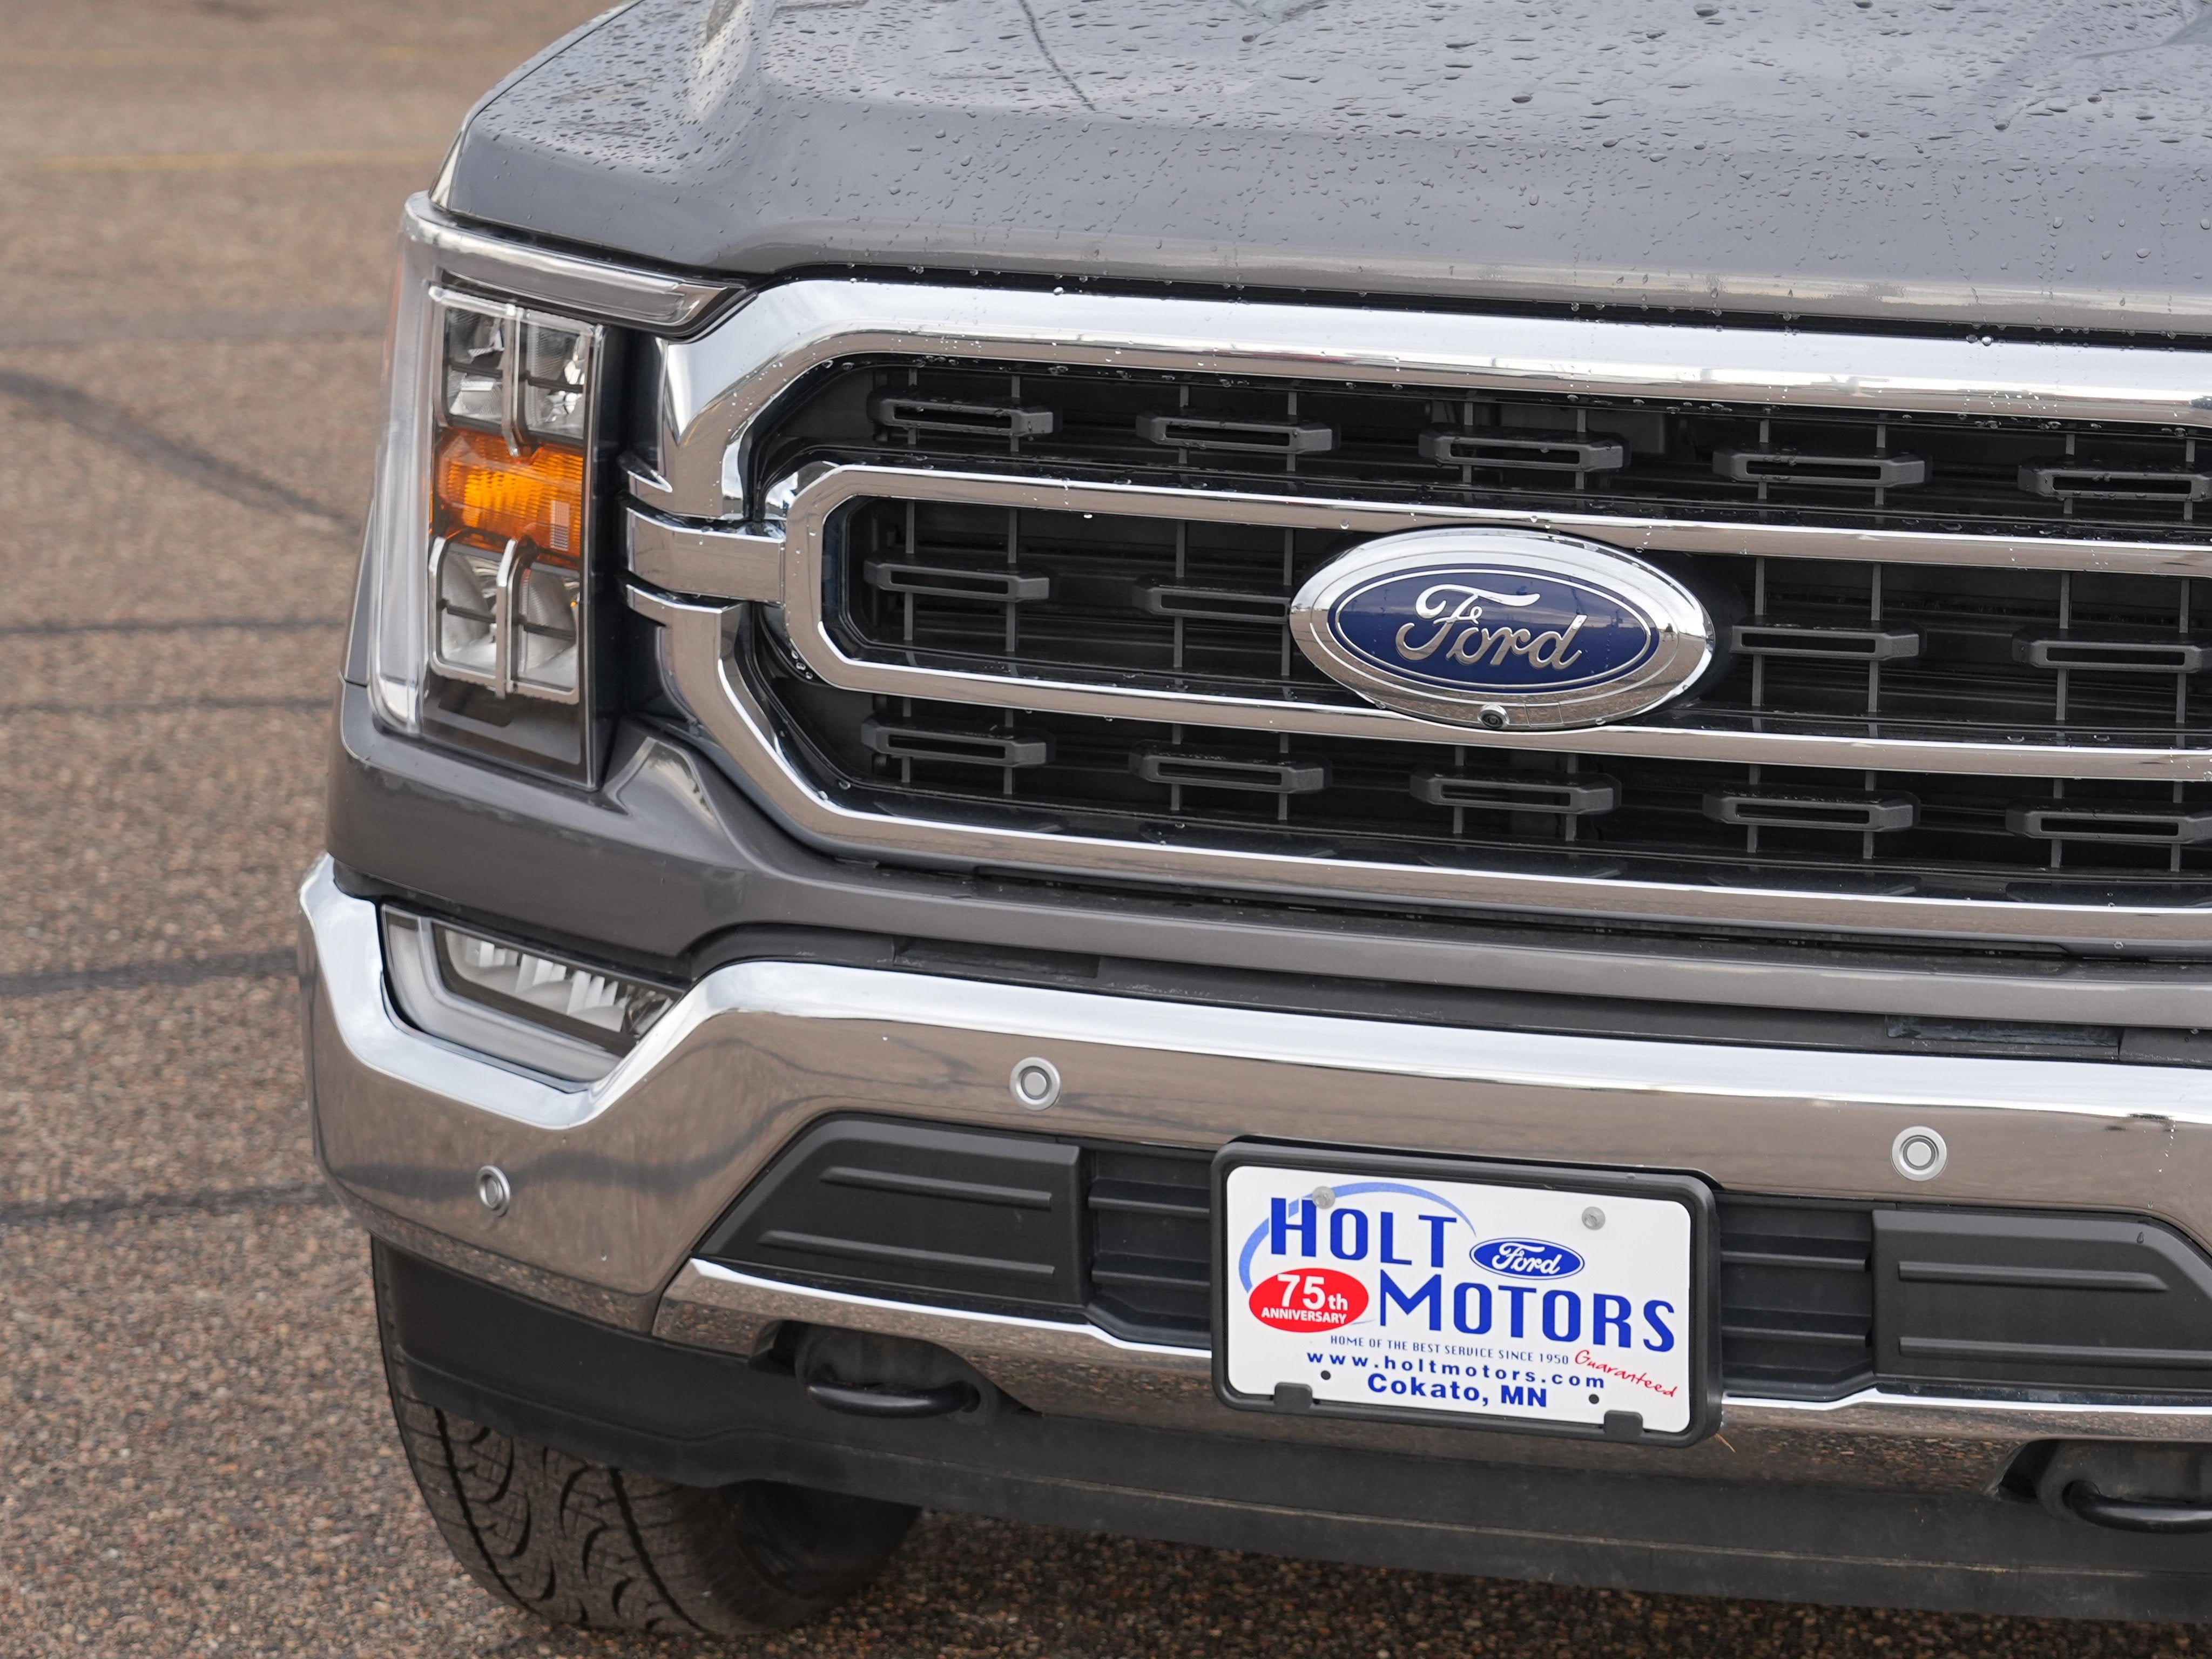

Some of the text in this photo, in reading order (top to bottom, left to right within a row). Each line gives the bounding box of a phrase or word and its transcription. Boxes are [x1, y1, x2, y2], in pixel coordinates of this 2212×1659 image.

[1395, 583, 1588, 670] Ford
[1271, 1197, 1457, 1268] HOLT
[1491, 1242, 1563, 1275] Ford
[1277, 1273, 1348, 1311] 75th
[1380, 1269, 1675, 1352] MOTORS
[1260, 1307, 1347, 1325] ANNIVERSARY
[1330, 1335, 1569, 1365] HOME OF THE BEST SERVICE SINCE 1950
[1306, 1352, 1605, 1388] www.holtmotors.com
[1574, 1349, 1678, 1398] Guaranteed
[1367, 1373, 1547, 1407] Cokato, MN
